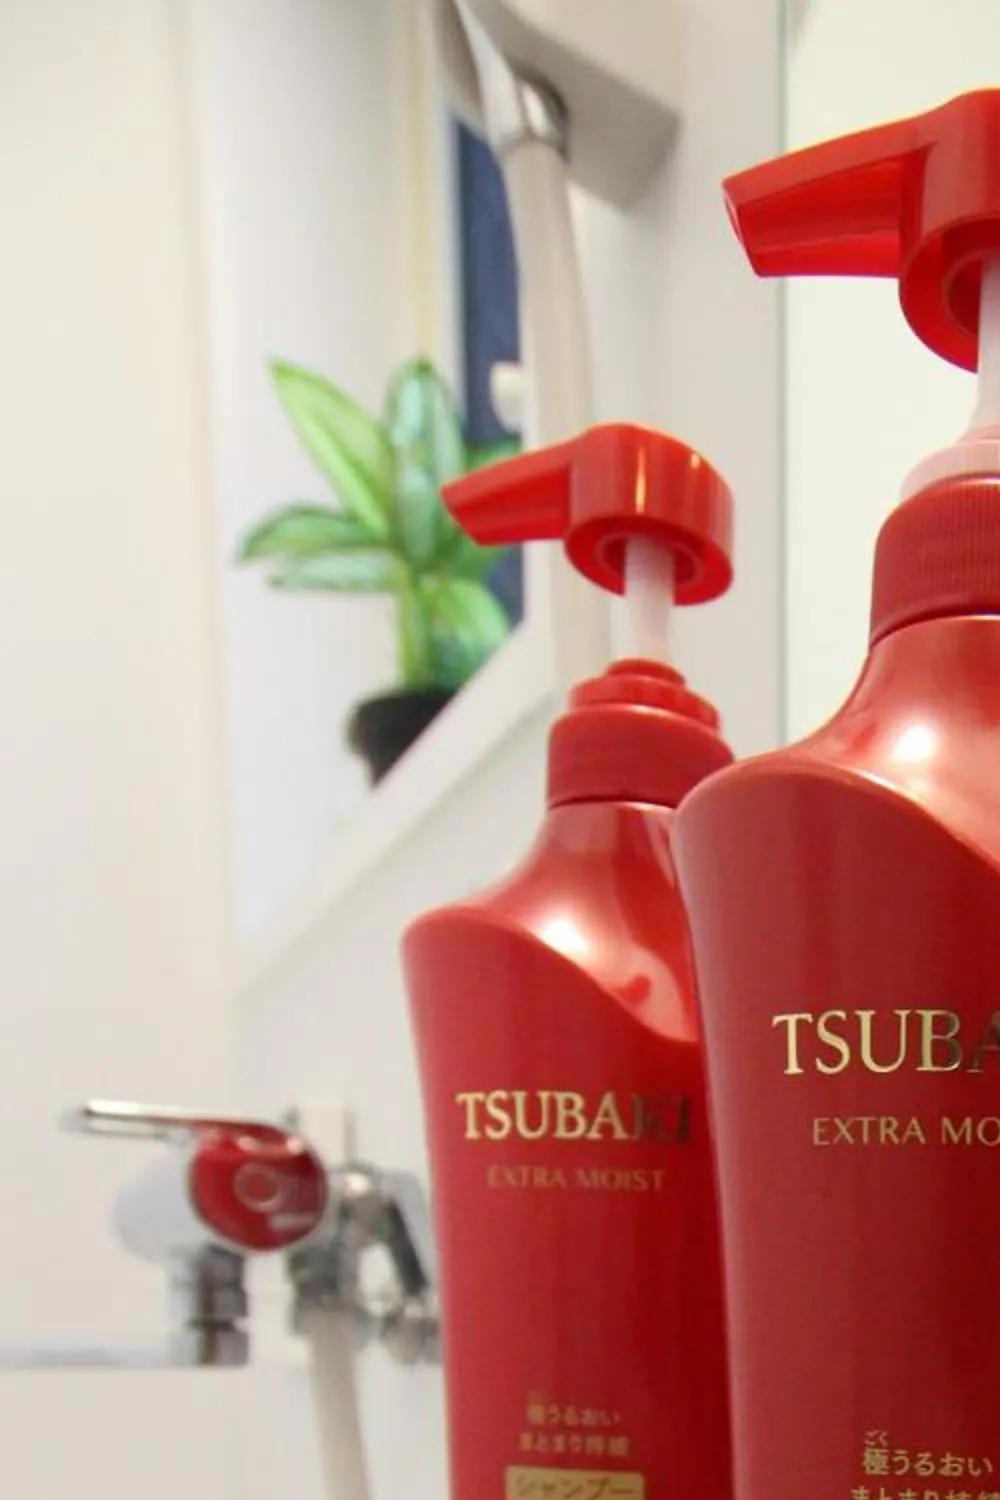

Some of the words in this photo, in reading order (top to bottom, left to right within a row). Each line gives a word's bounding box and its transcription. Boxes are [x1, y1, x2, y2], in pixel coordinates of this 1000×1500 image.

[455, 1089, 693, 1143] TSUBAKI
[812, 1117, 926, 1146] EXTRA
[486, 1164, 566, 1189] EXTRA
[575, 1166, 666, 1192] MOIST
